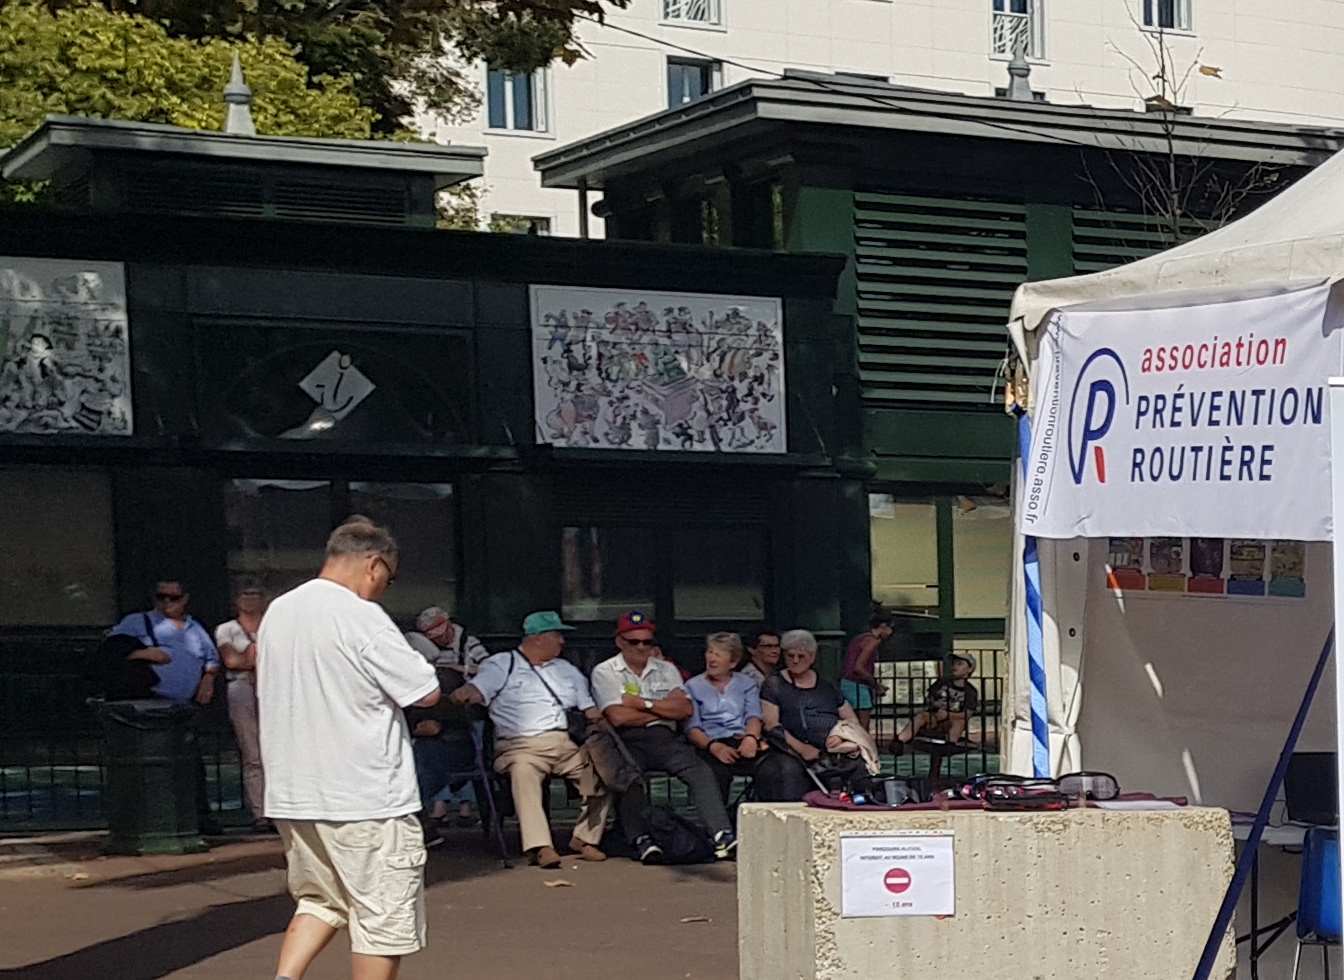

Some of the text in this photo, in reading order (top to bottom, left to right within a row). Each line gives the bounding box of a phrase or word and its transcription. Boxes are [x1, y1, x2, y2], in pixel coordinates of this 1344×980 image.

[1141, 333, 1287, 373] association
[1135, 384, 1323, 429] PRÉVENTION
[1131, 436, 1275, 483] ROUTIÈRE
